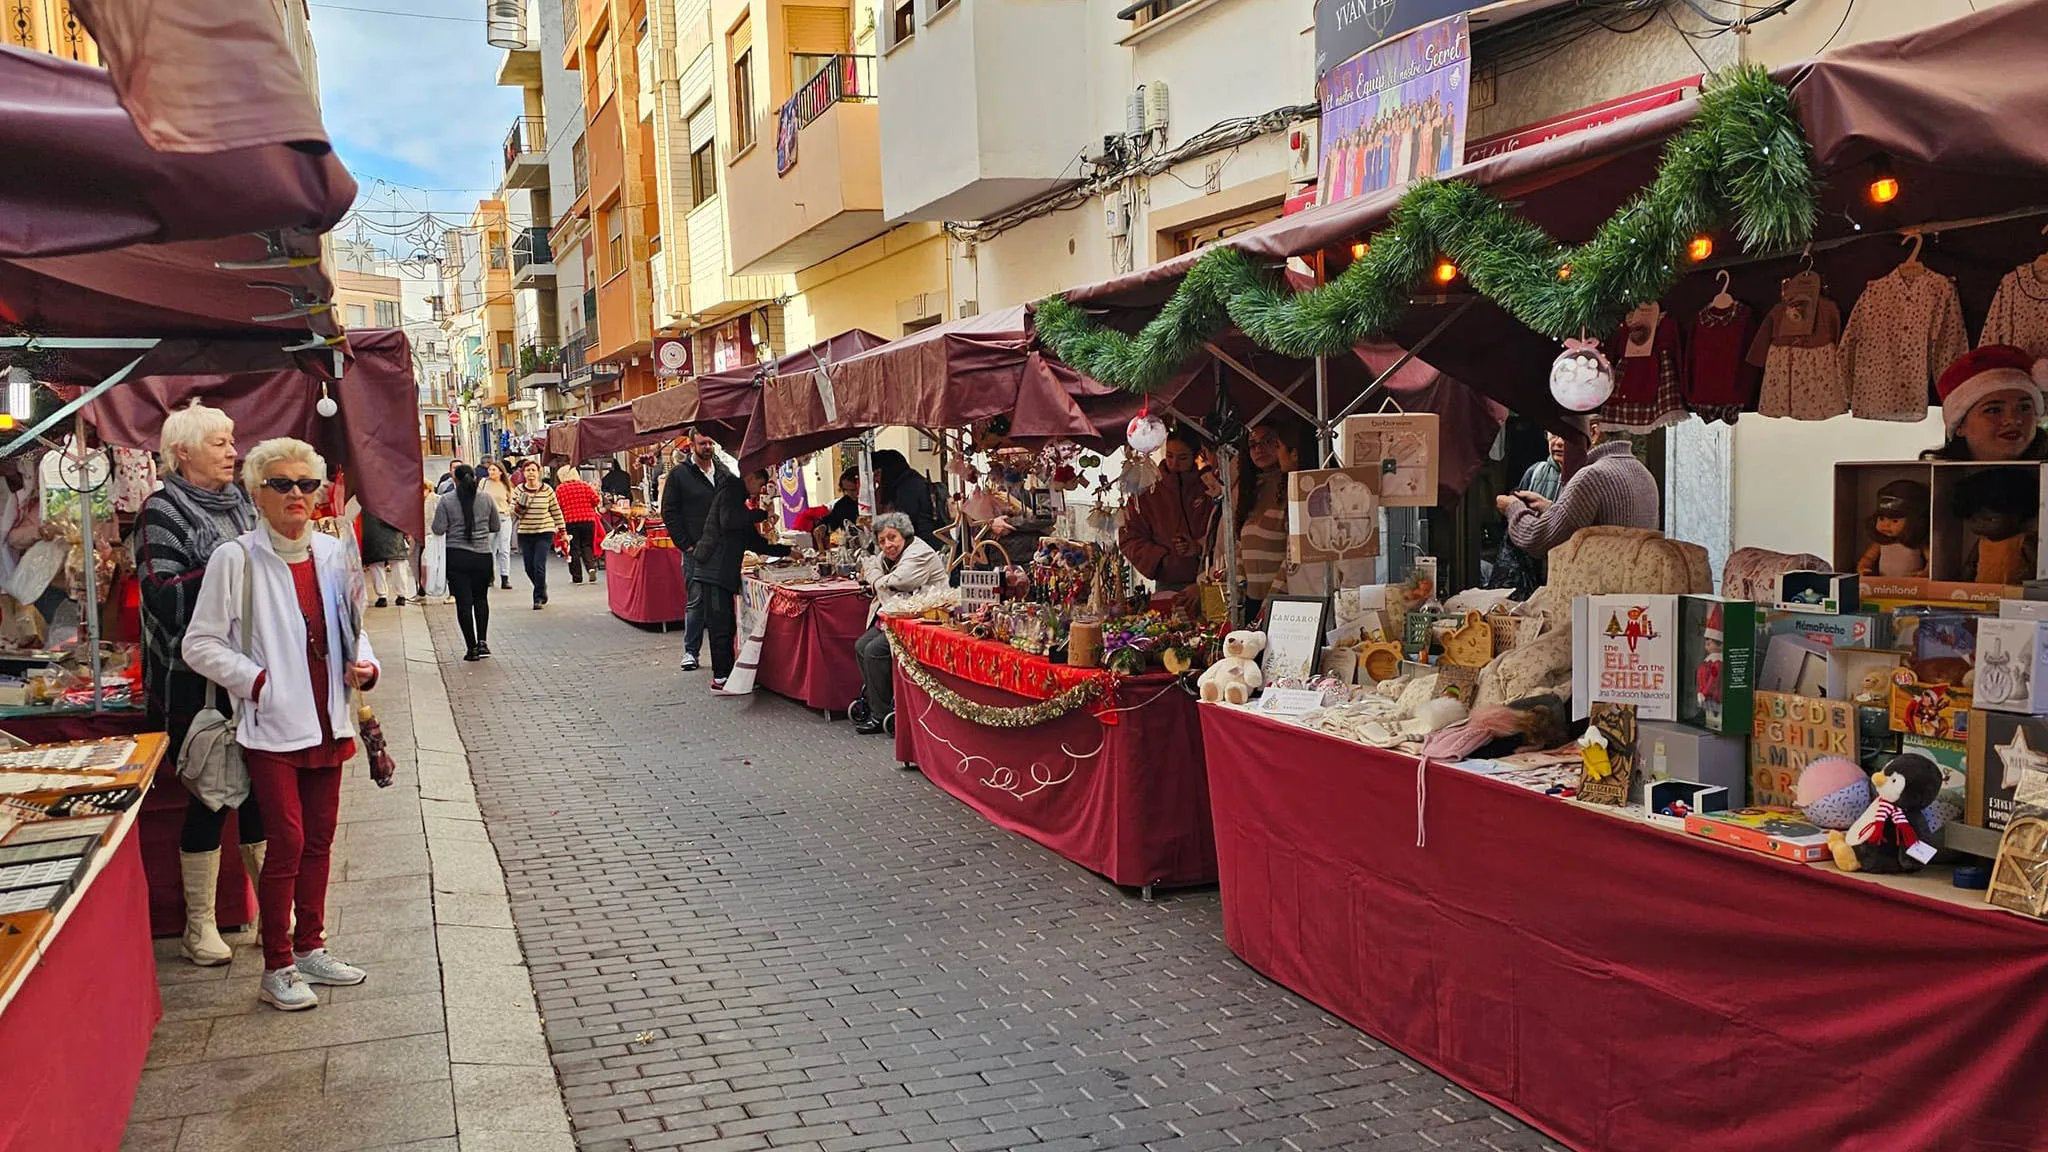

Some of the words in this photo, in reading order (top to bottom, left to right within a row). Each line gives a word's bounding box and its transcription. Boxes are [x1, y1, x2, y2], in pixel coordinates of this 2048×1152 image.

[1336, 0, 1367, 31] YVAN
[1325, 91, 1333, 112] El
[1336, 87, 1354, 106] nostre
[1399, 60, 1422, 82] nostre
[1424, 33, 1467, 73] Secret
[1873, 585, 1918, 596] miniland
[1604, 652, 1640, 671] ELF
[1650, 664, 1665, 672] the
[1601, 672, 1665, 690] SHELF
